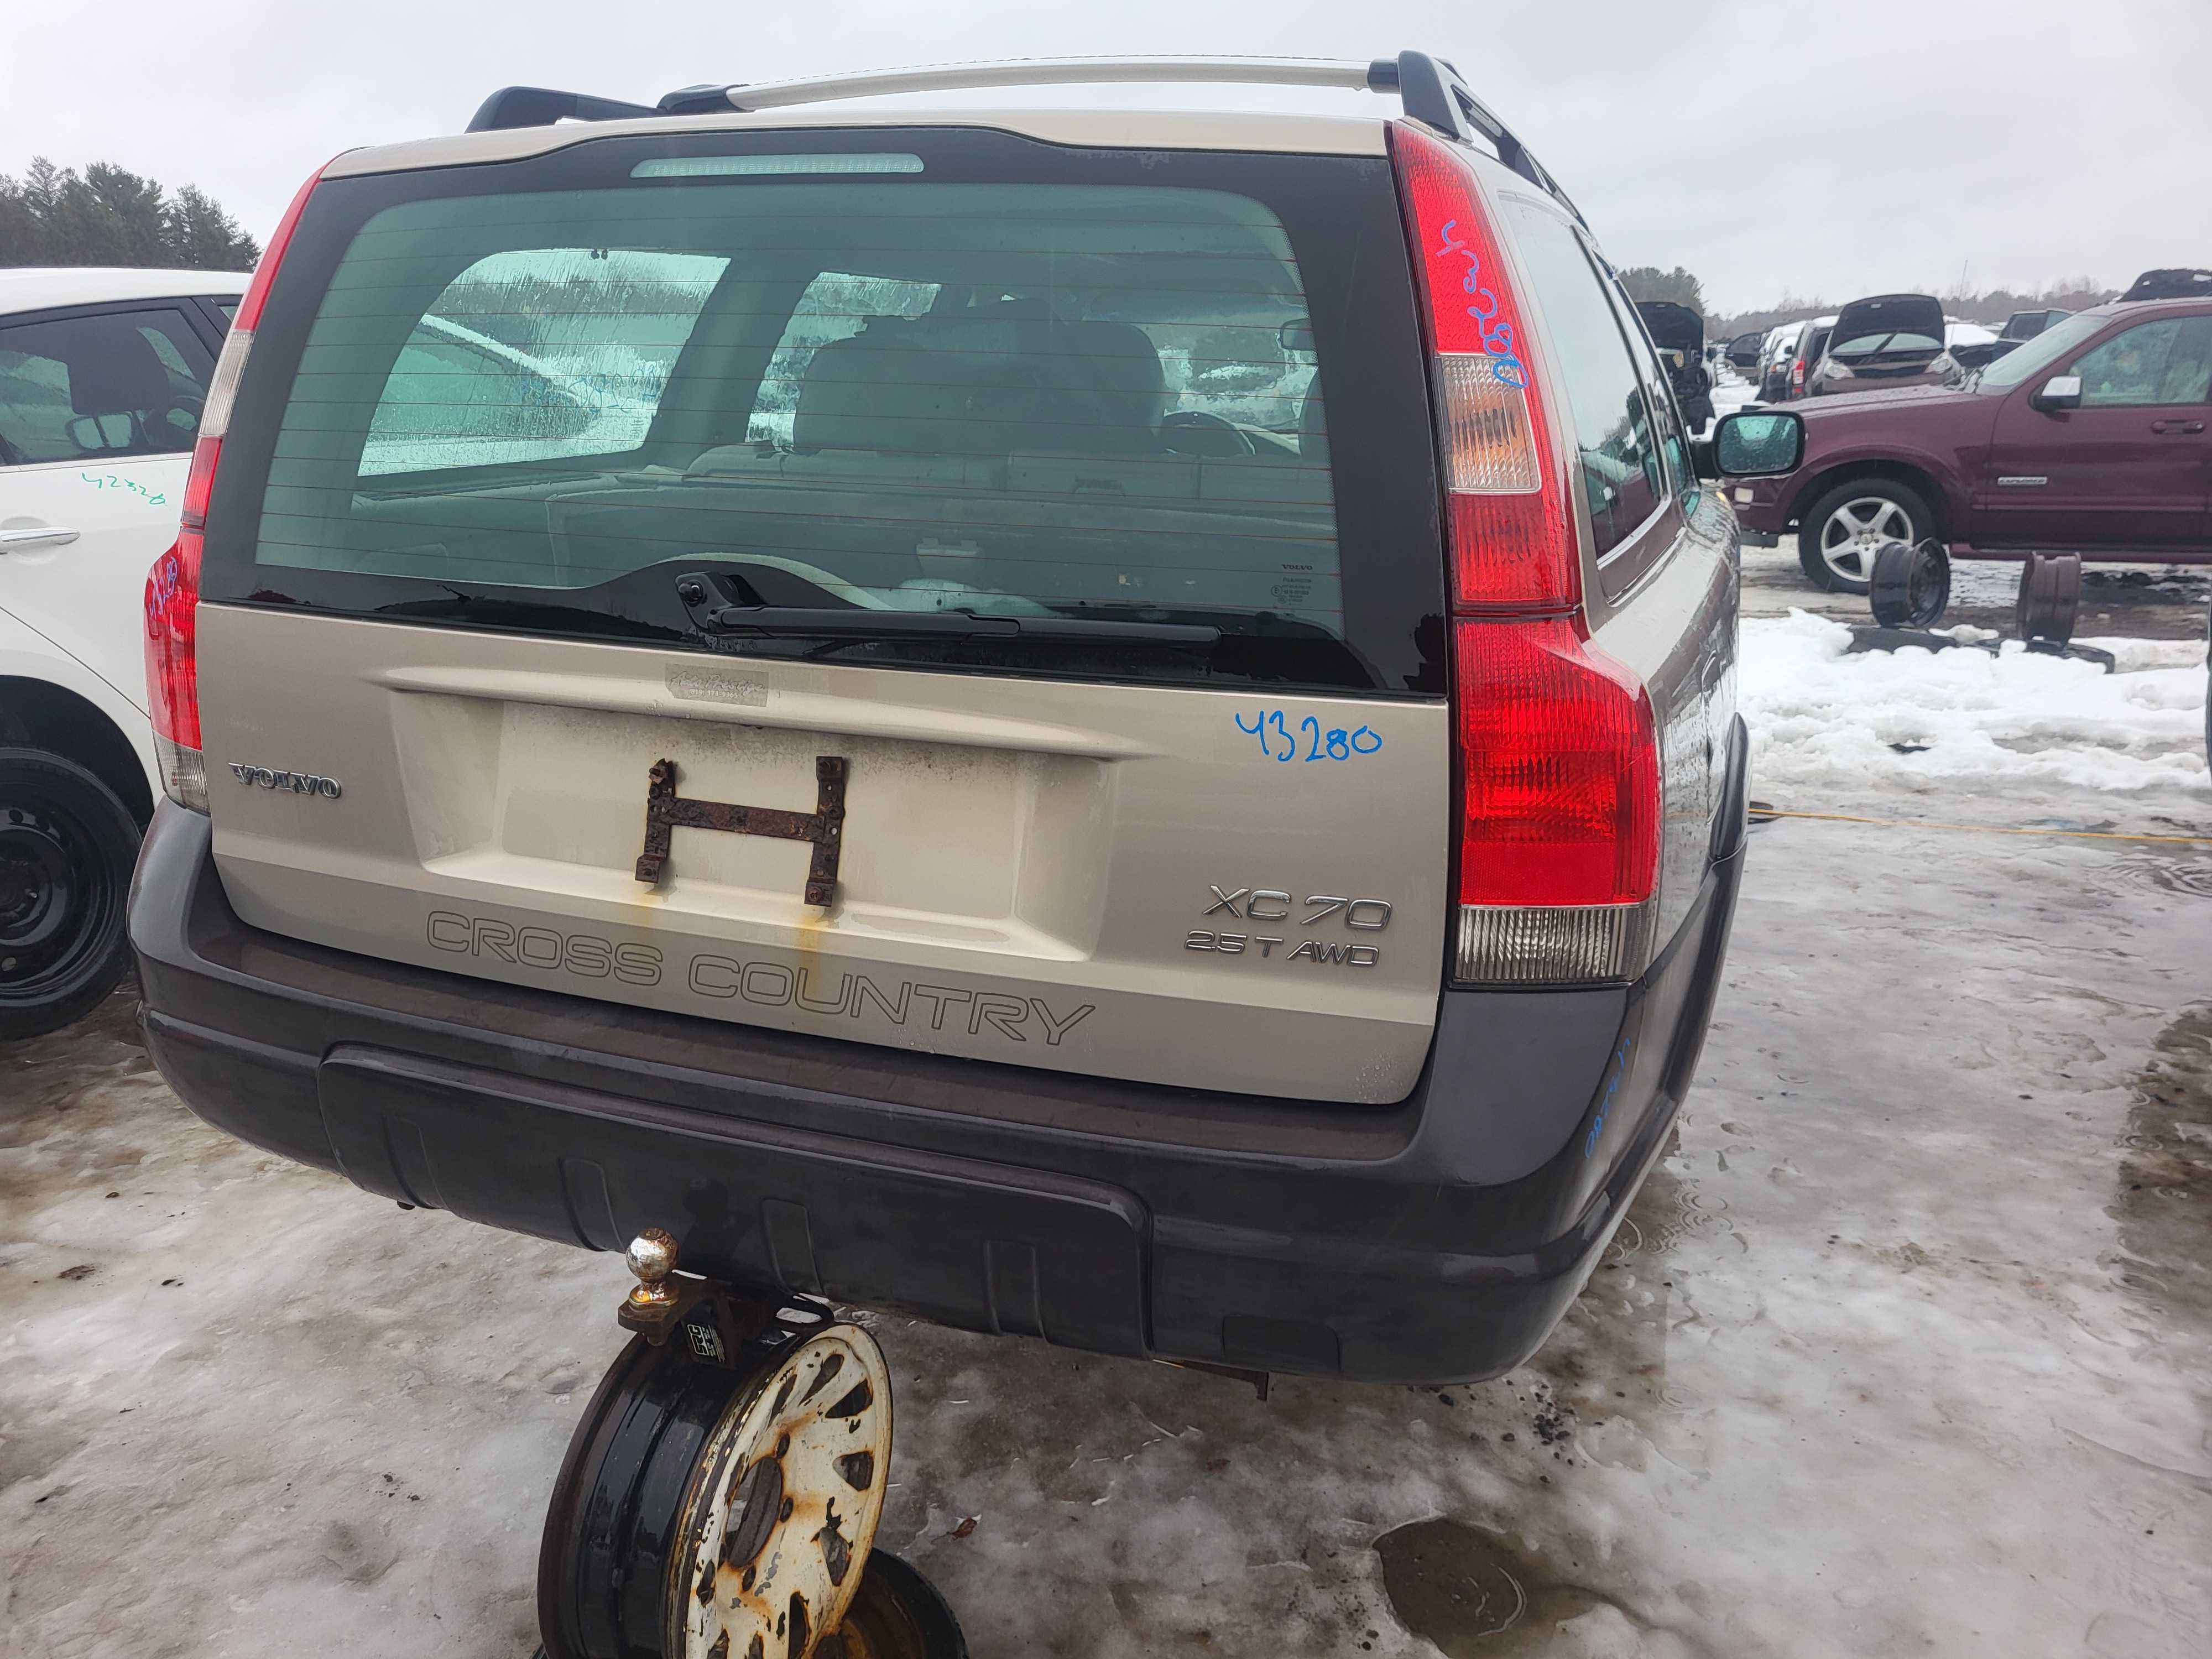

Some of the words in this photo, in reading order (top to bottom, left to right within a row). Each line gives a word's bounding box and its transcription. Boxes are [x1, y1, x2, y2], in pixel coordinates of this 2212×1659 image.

[1436, 220, 1529, 388] 43280
[704, 673, 765, 697] Prestige
[1235, 710, 1382, 762] 43280
[227, 762, 342, 799] VOLVO
[1202, 884, 1292, 921] XC
[1300, 895, 1392, 931] 70
[1286, 940, 1380, 968] AWD
[427, 910, 663, 986] CROSS
[688, 954, 1096, 1046] COUNTRY
